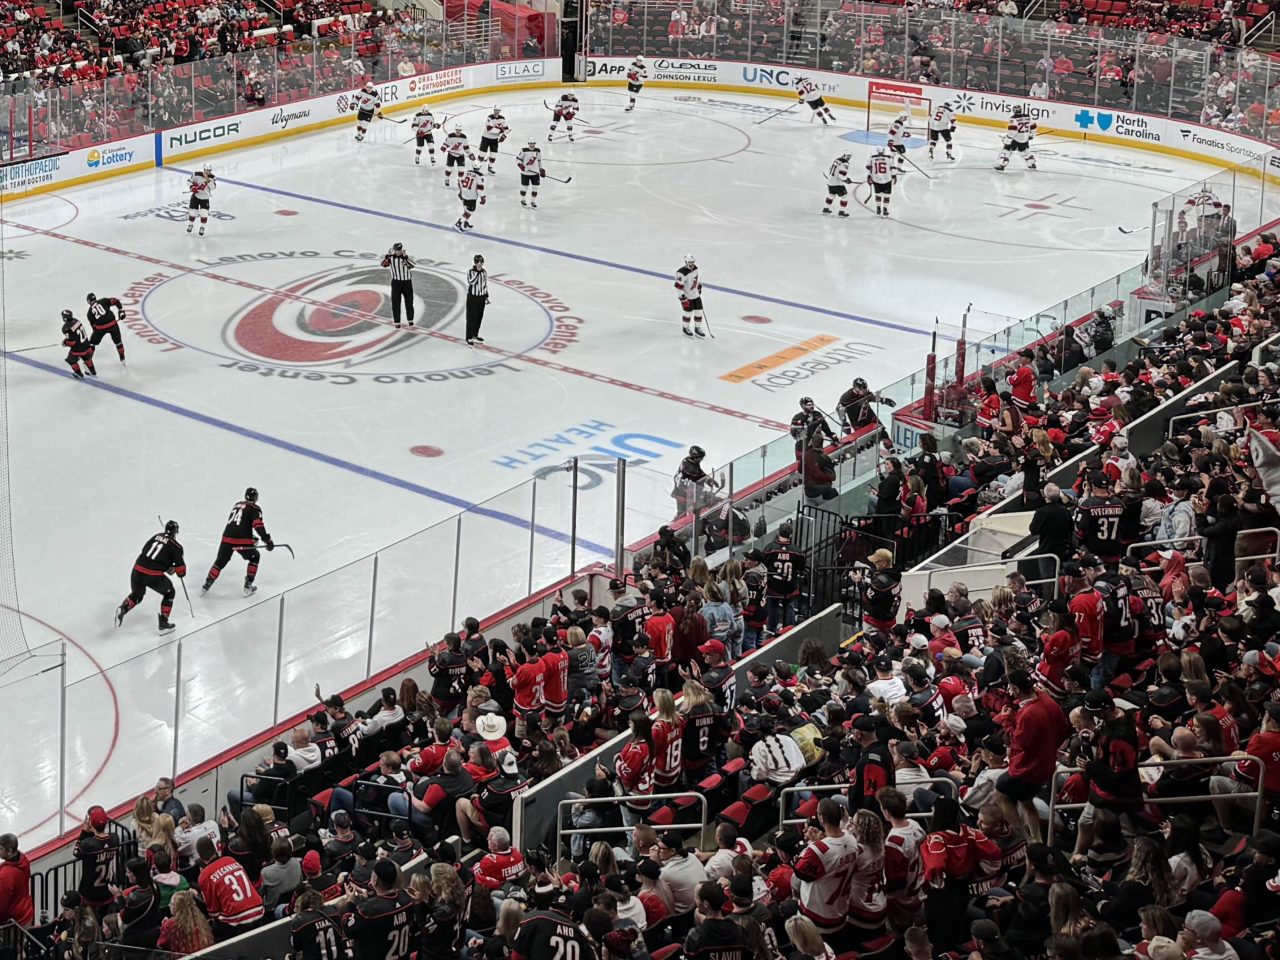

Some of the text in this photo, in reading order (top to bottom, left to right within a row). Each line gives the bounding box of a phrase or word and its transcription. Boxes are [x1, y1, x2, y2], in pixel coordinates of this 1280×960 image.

[435, 69, 462, 80] SURGERY
[500, 63, 540, 76] SILAC
[669, 62, 717, 71] LEXUS
[743, 66, 790, 86] UNC
[653, 73, 717, 83] JOHNSON LEXUS
[271, 107, 311, 129] Wegmans
[935, 111, 943, 122] 5
[1116, 114, 1148, 128] North
[170, 122, 240, 148] NUCOR
[1115, 125, 1161, 141] Carolina
[1192, 133, 1224, 150] Fanatics
[102, 150, 134, 166] Lottery
[9, 157, 60, 179] ORTHOPAEDIC
[874, 162, 887, 174] 16
[10, 174, 53, 189] TEAM DOCTORS
[196, 248, 320, 267] Lenovo
[123, 271, 171, 310] Center
[91, 304, 106, 320] 20
[219, 361, 524, 387] Lenovo Center
[491, 419, 616, 470] HEALTH
[1097, 517, 1119, 541] 37
[146, 541, 163, 560] 11
[773, 561, 792, 581] 20
[1147, 598, 1164, 625] 37
[699, 728, 709, 751] 8
[665, 737, 682, 770] 18
[222, 872, 254, 903] 37
[393, 911, 408, 928] AHO
[556, 924, 574, 938] AHO
[387, 925, 411, 960] 20
